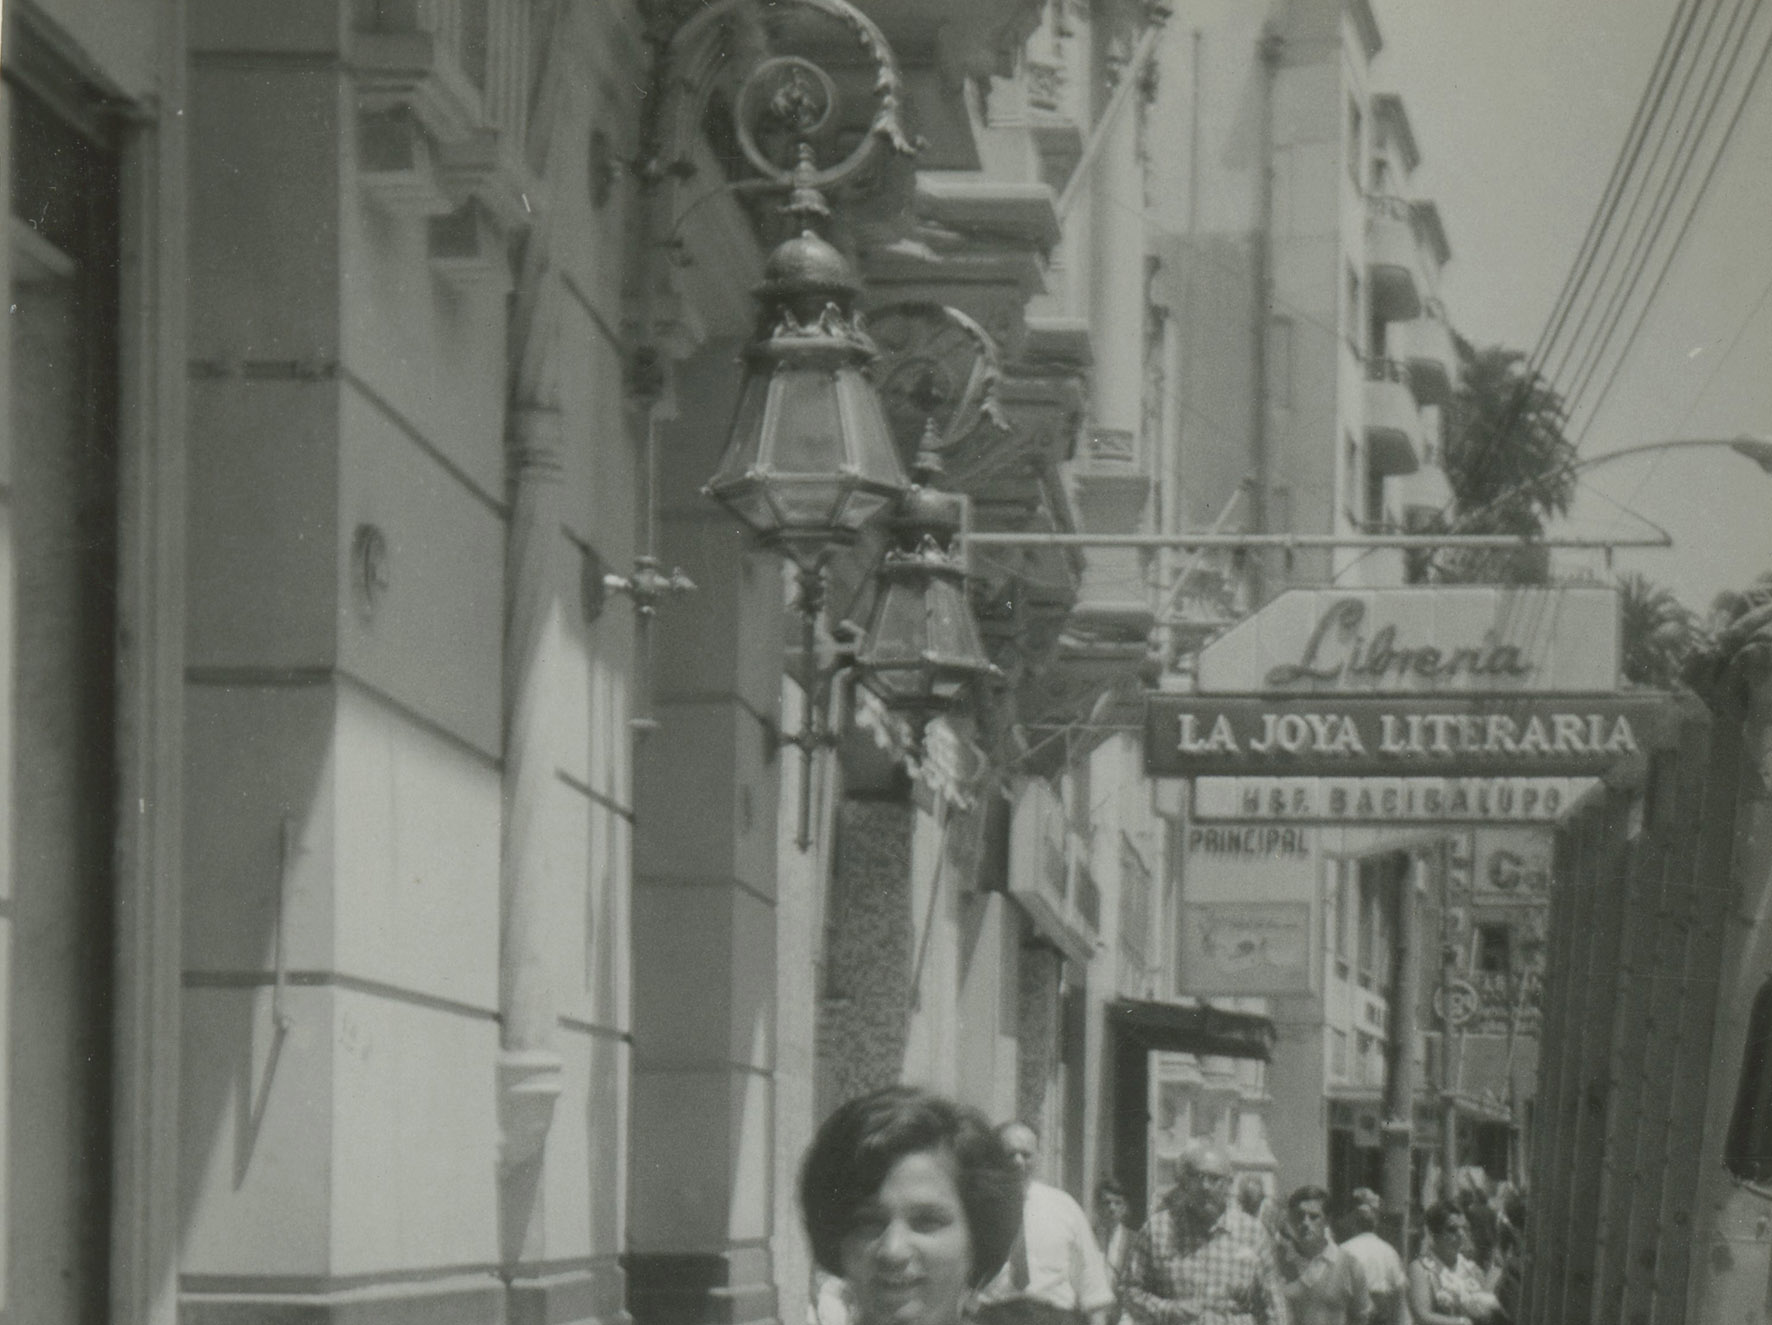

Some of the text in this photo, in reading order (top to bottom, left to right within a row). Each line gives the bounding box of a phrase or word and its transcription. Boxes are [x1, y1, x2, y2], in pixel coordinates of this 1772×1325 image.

[1177, 713, 1638, 752] LA JOYA LITERARIA
[1190, 828, 1309, 854] PRINCIPAL
